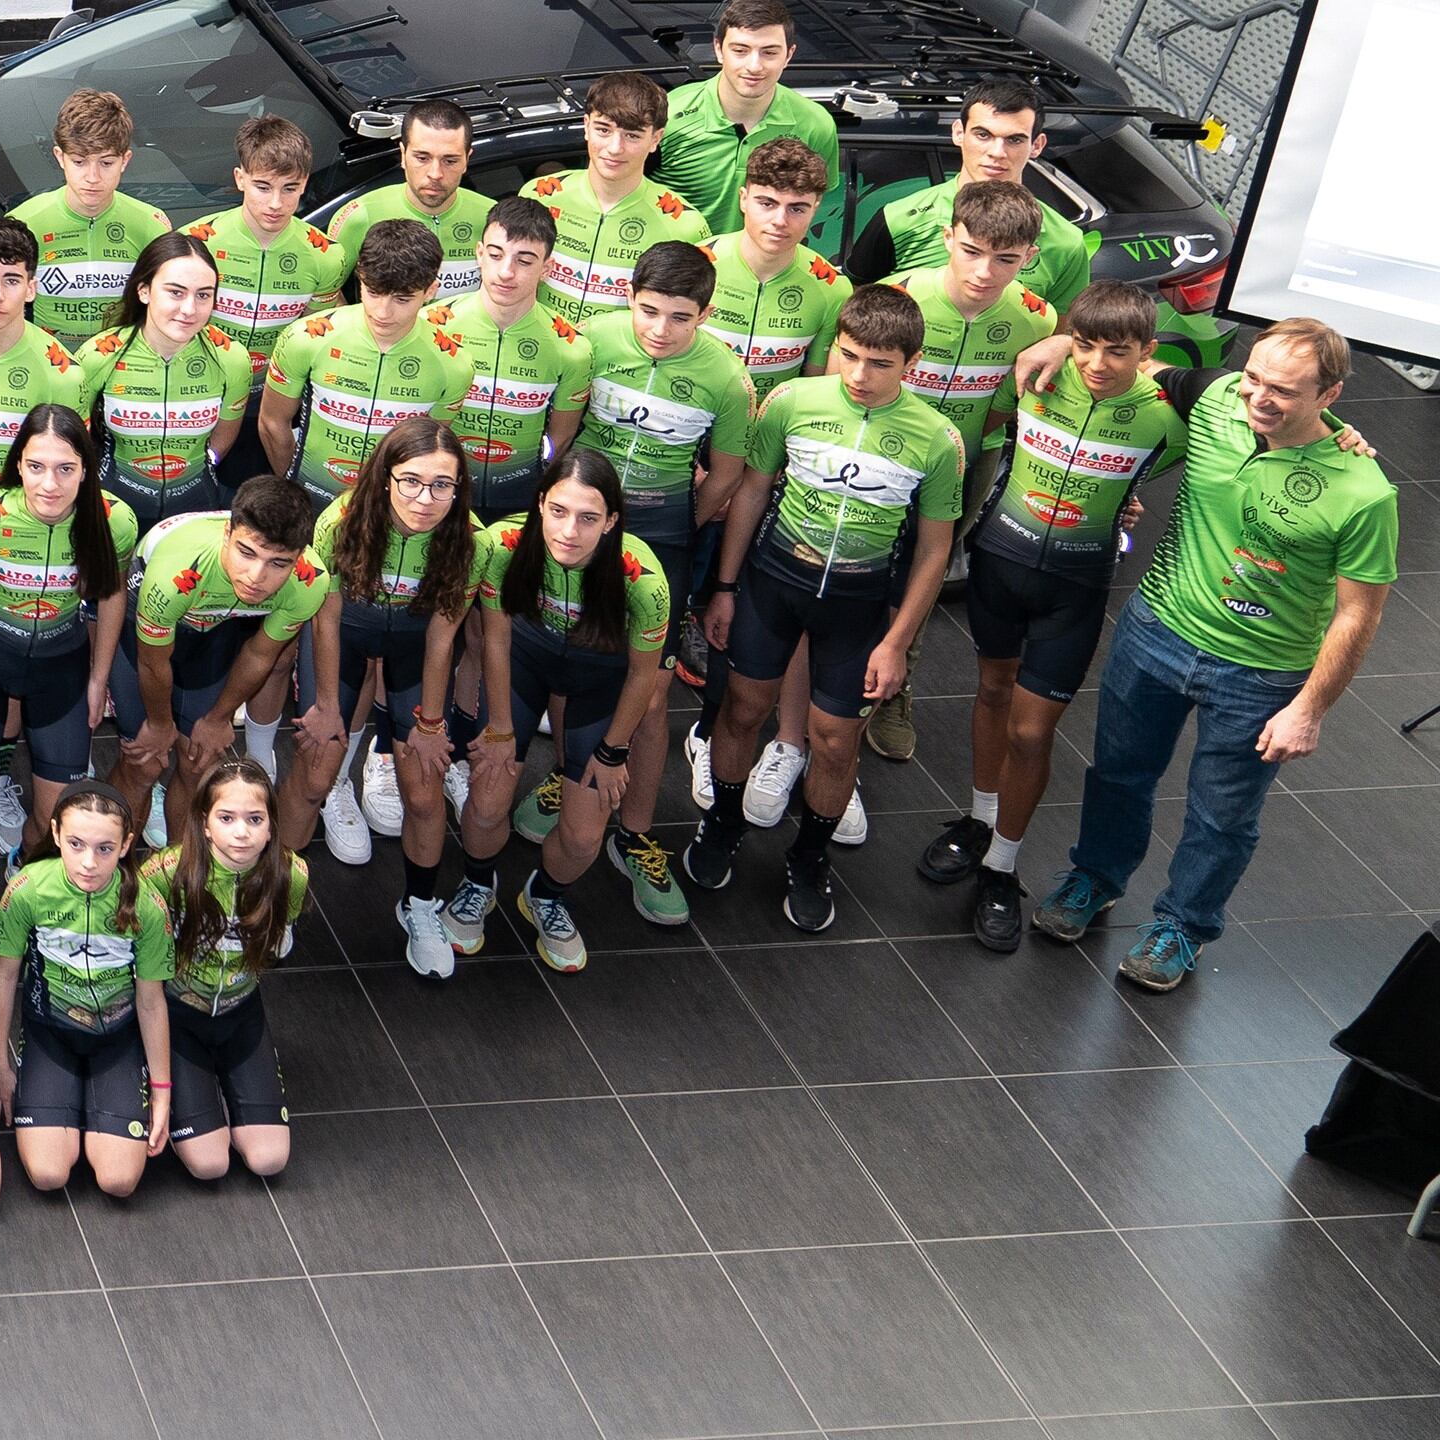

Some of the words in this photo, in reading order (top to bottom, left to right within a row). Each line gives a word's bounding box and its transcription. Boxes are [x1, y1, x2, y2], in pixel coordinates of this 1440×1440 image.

[1119, 232, 1220, 268] vive
[906, 376, 1003, 393] SUPERMERCADOS
[121, 418, 213, 429] SUPERMERCADOS
[1032, 440, 1124, 473] SUPERMERCADOS
[1026, 460, 1101, 494] Huesca
[1259, 491, 1299, 525] vive
[998, 512, 1041, 544] SERFEY
[1225, 598, 1267, 616] vulco
